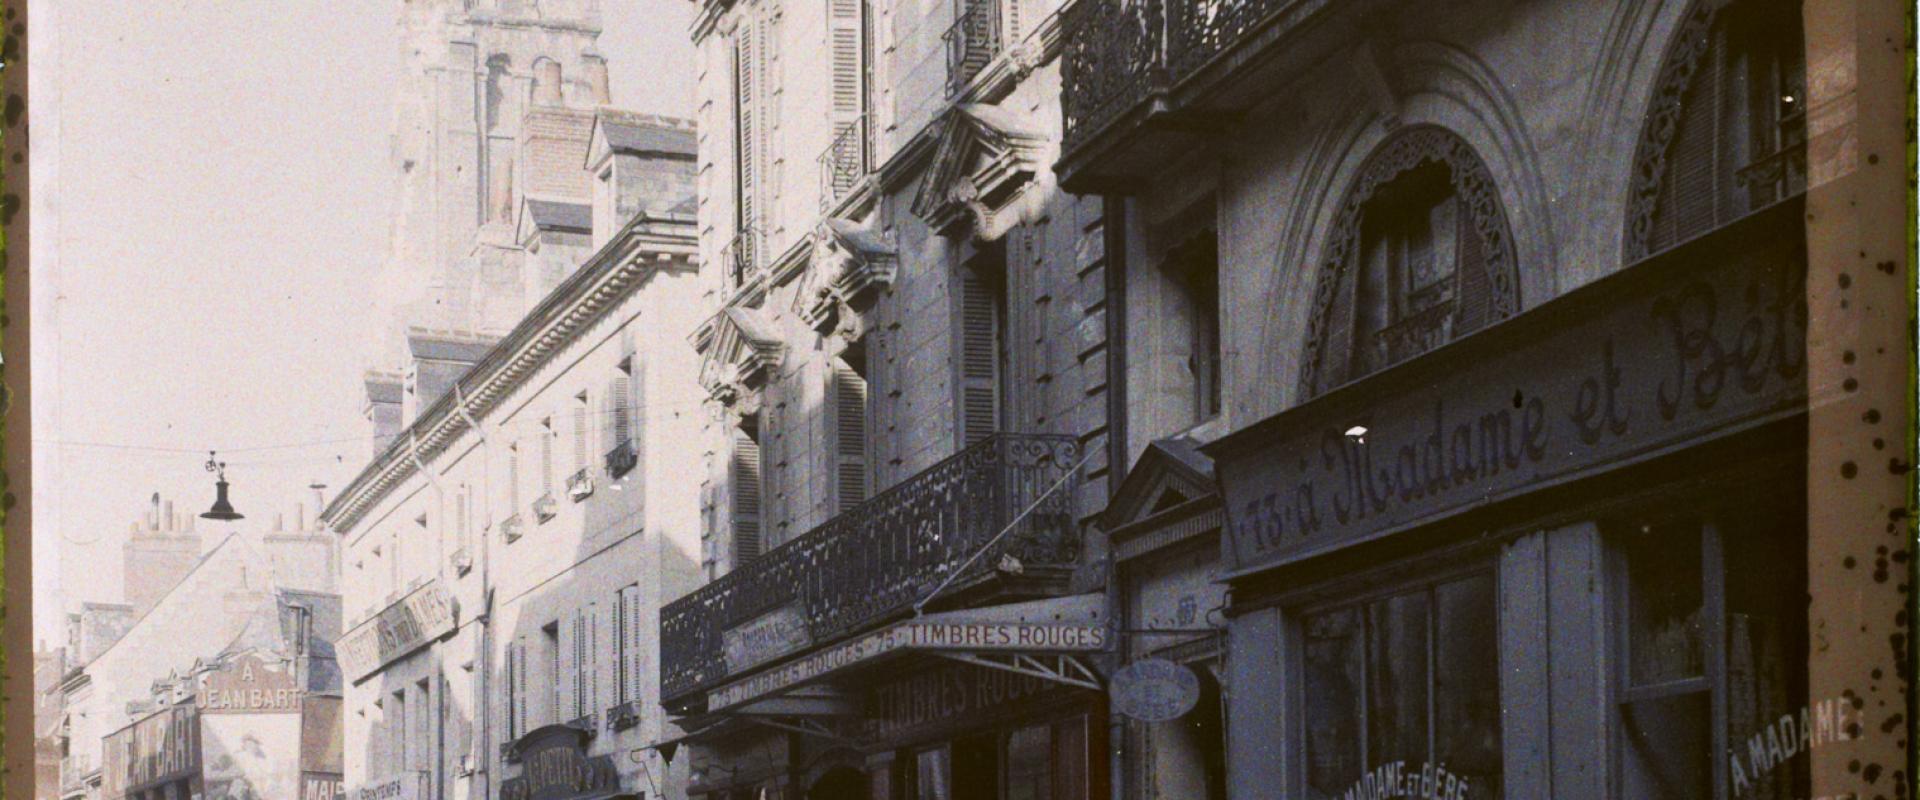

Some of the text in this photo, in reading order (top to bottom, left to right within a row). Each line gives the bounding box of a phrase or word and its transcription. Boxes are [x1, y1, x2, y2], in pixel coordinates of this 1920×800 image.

[1320, 401, 1547, 525] Madame
[1576, 334, 1631, 445] et
[912, 624, 1105, 647] TIMBRES ROUGES
[242, 663, 255, 684] A
[807, 645, 864, 677] ROUGES
[199, 688, 301, 710] JEAN BART
[1747, 698, 1852, 779] MADAME
